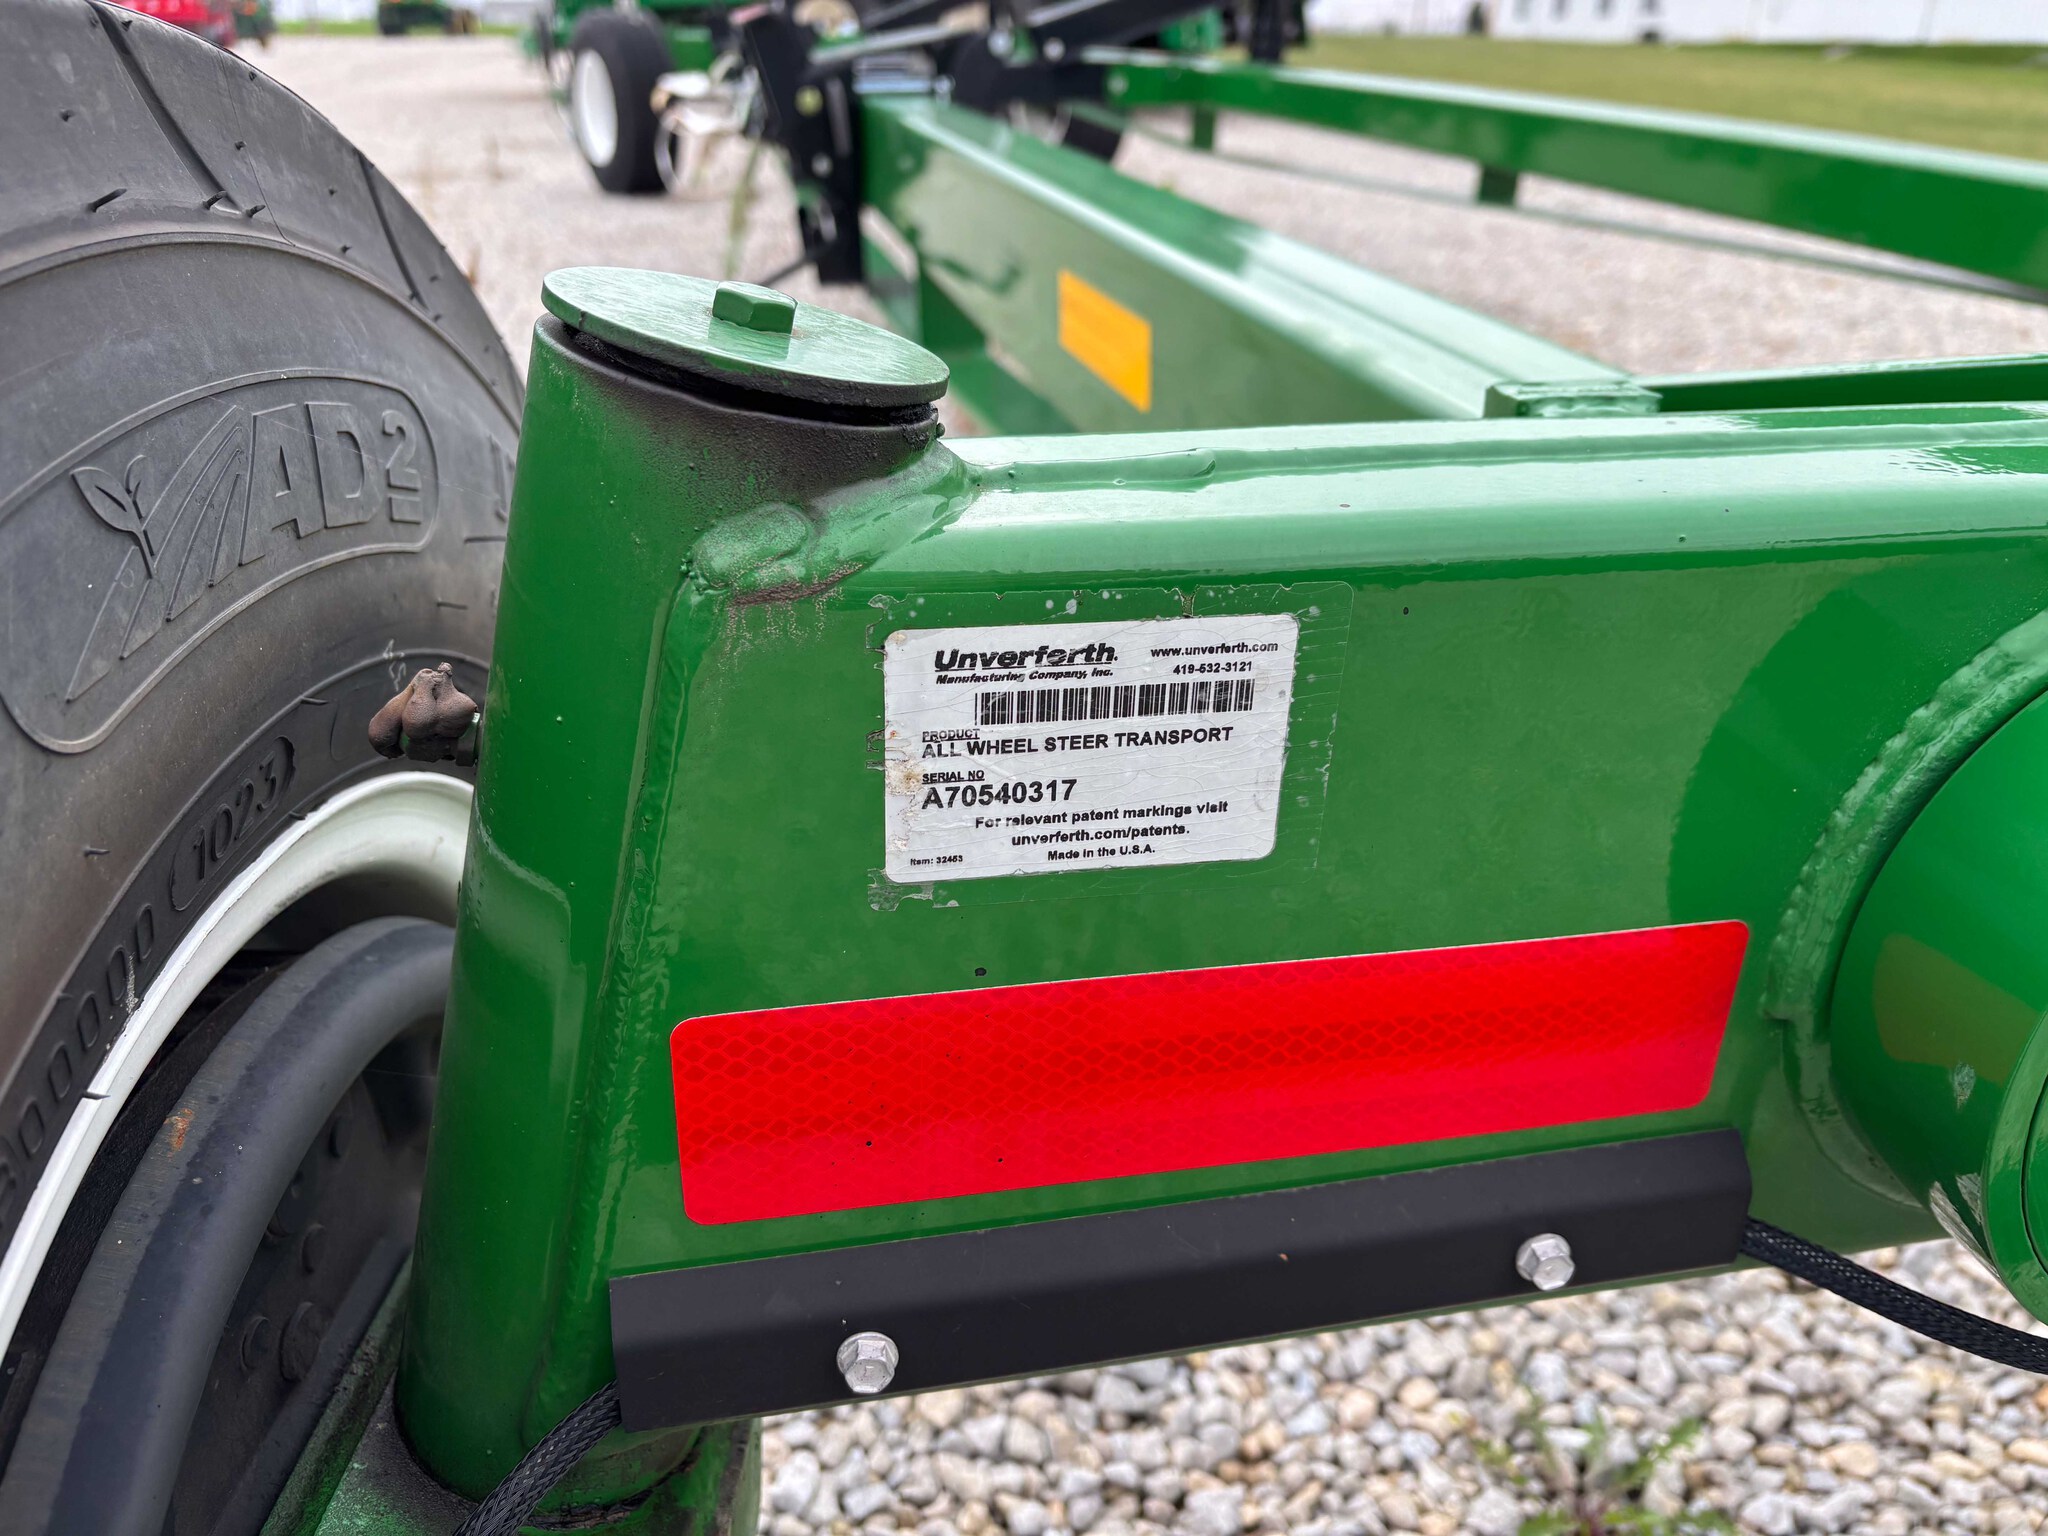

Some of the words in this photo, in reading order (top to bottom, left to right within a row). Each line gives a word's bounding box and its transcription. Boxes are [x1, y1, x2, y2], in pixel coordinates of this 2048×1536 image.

[1151, 642, 1279, 657] www.unverferth.com
[936, 672, 1025, 684] Manufacturing
[1028, 669, 1087, 681] Company,
[1091, 667, 1114, 677] Inc.
[1173, 661, 1252, 675] 419-532-3121
[922, 729, 980, 742] PRODUCT
[922, 743, 961, 758] ALL
[967, 739, 1038, 755] WHEEL
[1044, 734, 1108, 750] STEER
[1114, 727, 1233, 747] TRANSPORT
[922, 773, 964, 783] SERIAL
[968, 770, 985, 781] NO
[922, 779, 1077, 809] A70540317
[975, 816, 1001, 828] For
[1005, 811, 1067, 826] relevant
[1071, 808, 1119, 824] patent
[1123, 804, 1192, 821] markings
[1196, 801, 1228, 814] visit
[1012, 823, 1190, 846] unverferth.com/patents.
[1048, 850, 1080, 861] Made
[1083, 848, 1094, 858] in
[1097, 847, 1117, 856] the
[1120, 844, 1156, 855] U.S.A.
[910, 858, 934, 866] Item:
